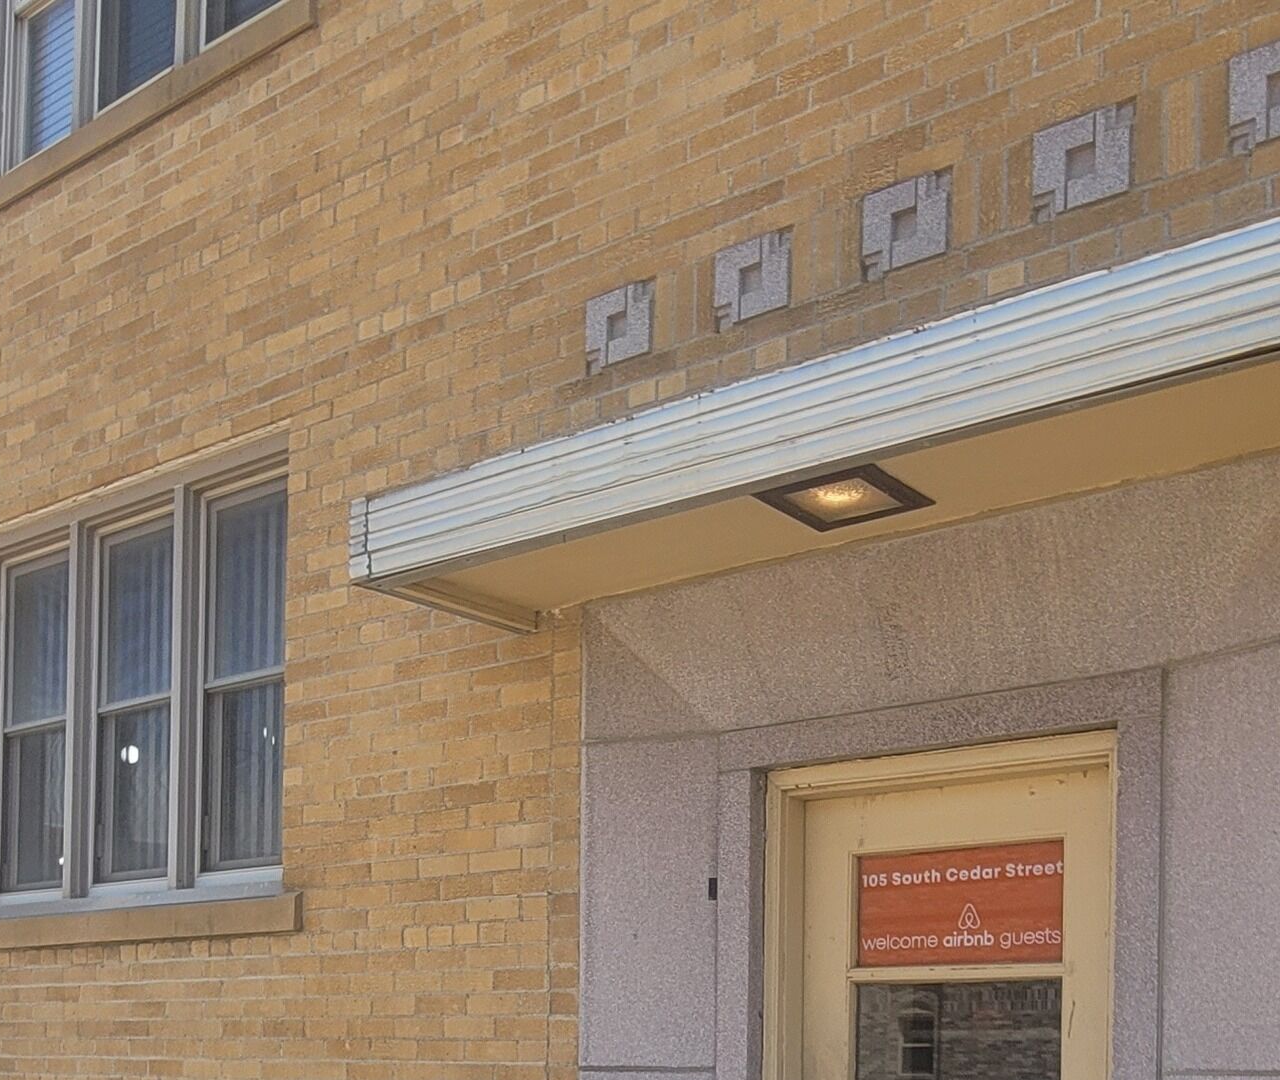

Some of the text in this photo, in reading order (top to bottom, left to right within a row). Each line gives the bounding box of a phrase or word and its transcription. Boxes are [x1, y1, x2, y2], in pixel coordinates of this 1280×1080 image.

[862, 860, 1063, 888] 105 South Cedar Street
[862, 927, 1062, 951] welcome airbnb guests
